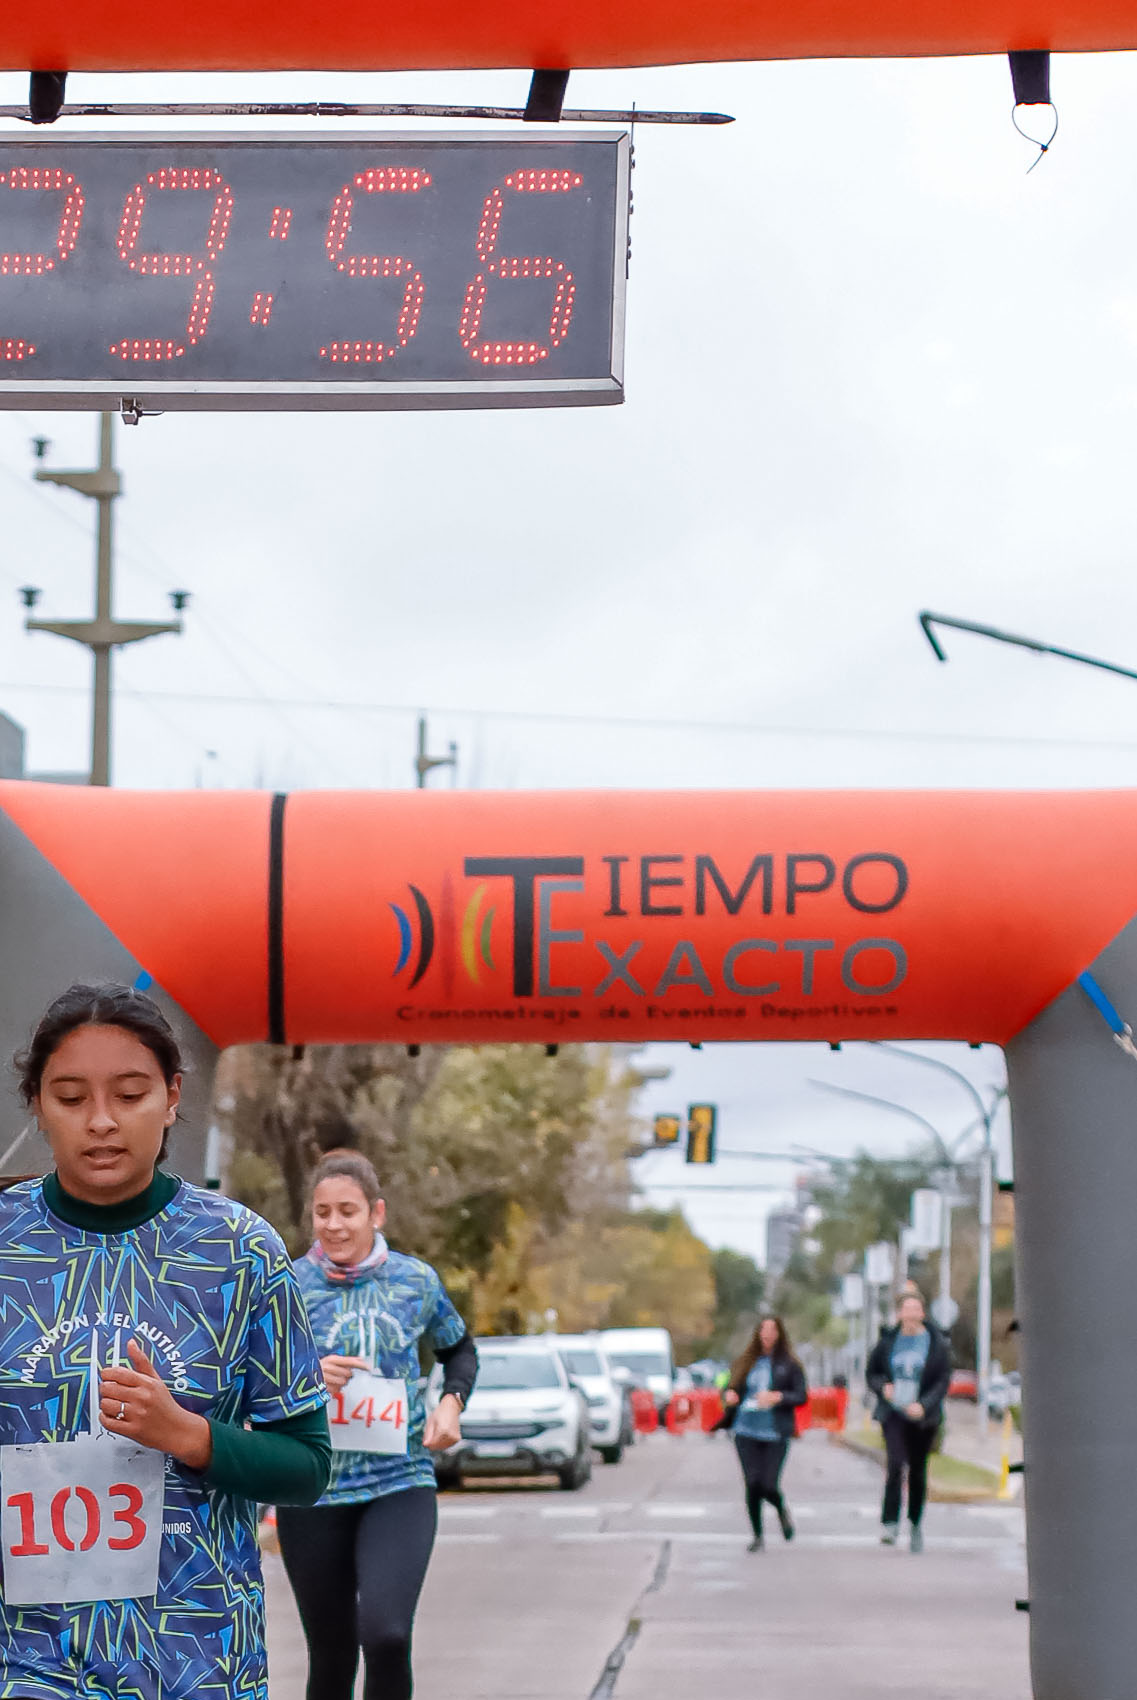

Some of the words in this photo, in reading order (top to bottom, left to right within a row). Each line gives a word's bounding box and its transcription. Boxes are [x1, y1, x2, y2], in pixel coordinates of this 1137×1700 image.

[538, 880, 910, 998] EXACTO
[94, 1312, 108, 1326] X
[113, 1312, 131, 1329] EL
[135, 1320, 189, 1392] AUTISMO
[330, 1391, 405, 1430] 144
[6, 1483, 147, 1557] 103
